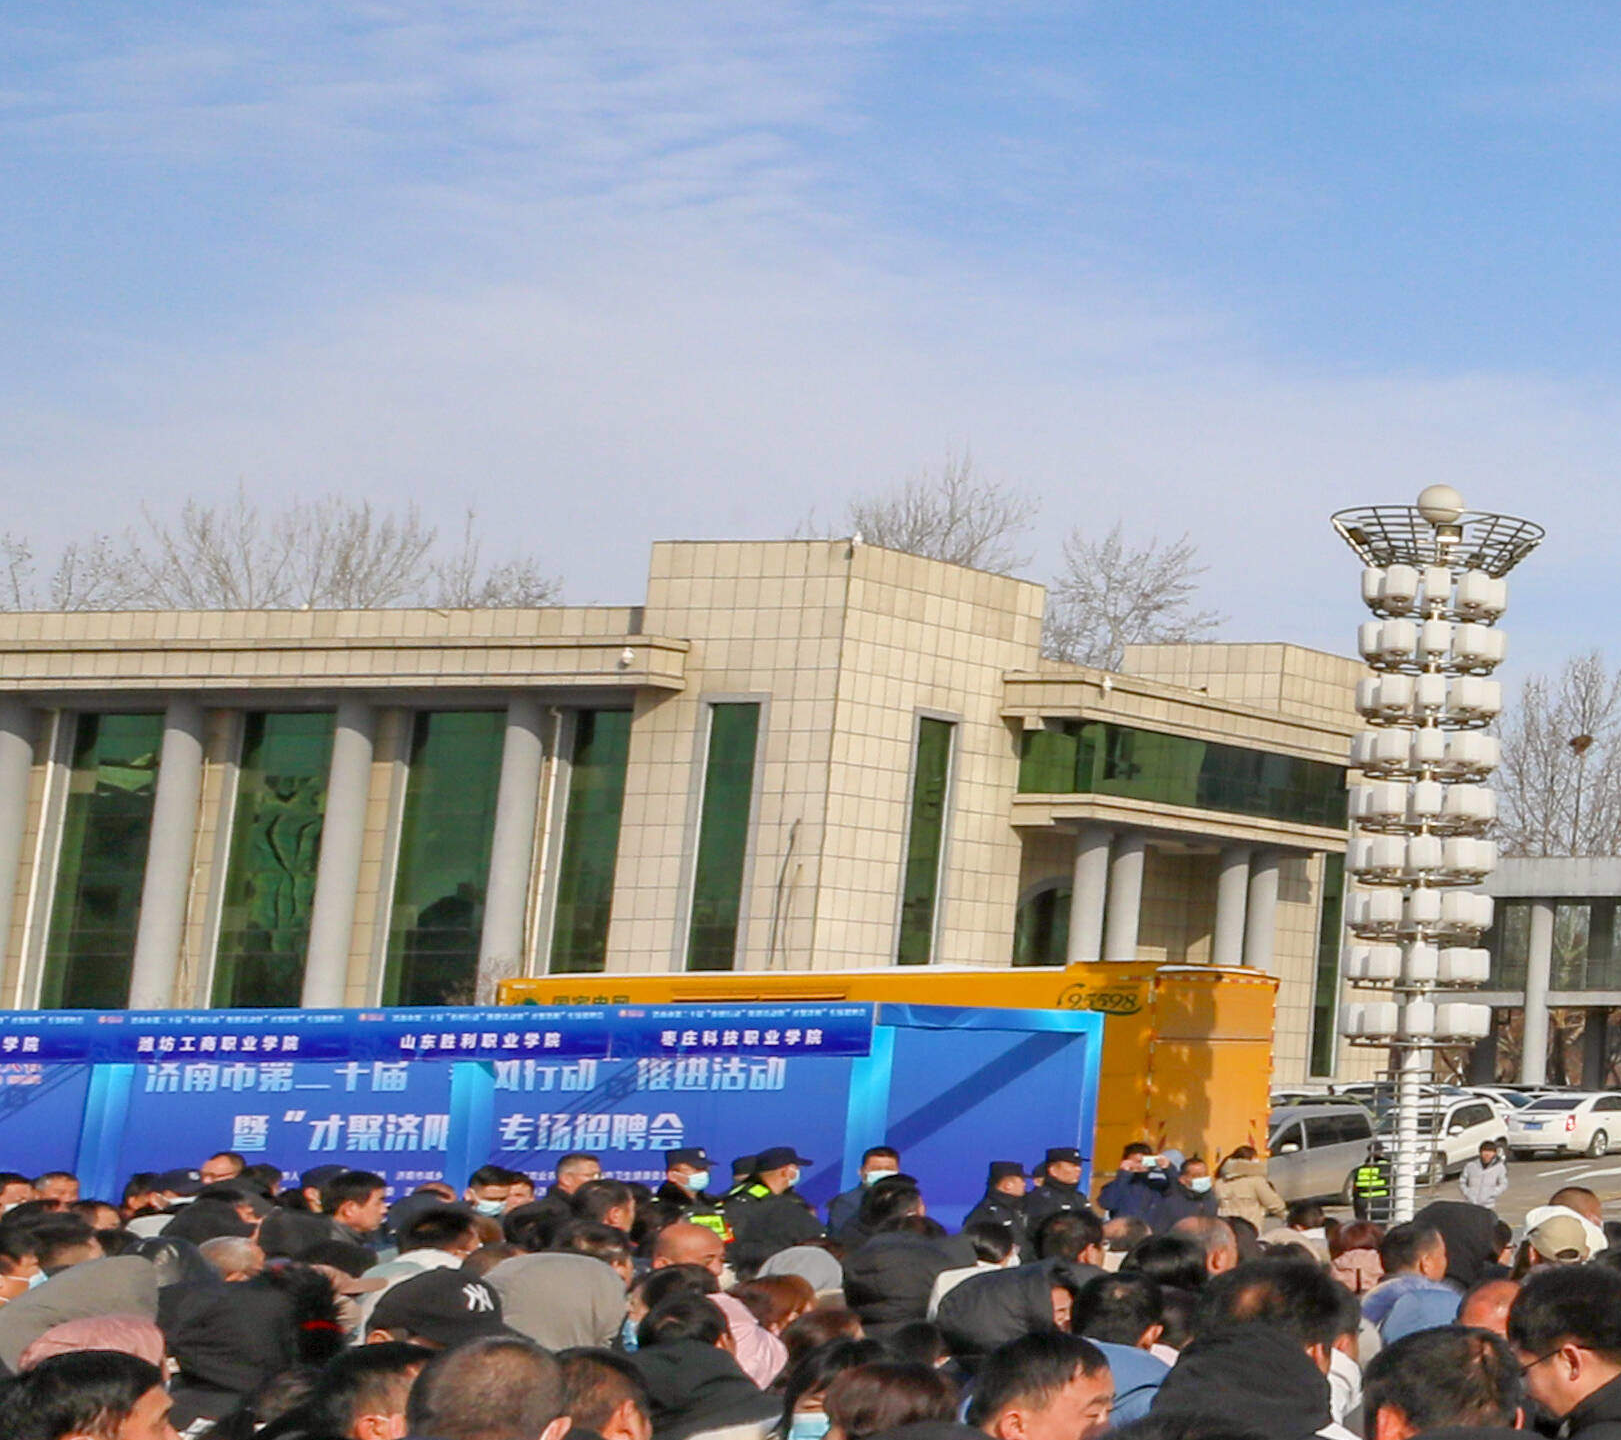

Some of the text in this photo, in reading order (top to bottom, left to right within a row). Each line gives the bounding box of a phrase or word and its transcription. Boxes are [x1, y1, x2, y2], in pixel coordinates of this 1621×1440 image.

[137, 1035, 300, 1052] 潍坊工商职业学院
[400, 1032, 562, 1050] 山东胜利职业学院
[660, 1029, 823, 1047] 枣庄科技职业学院
